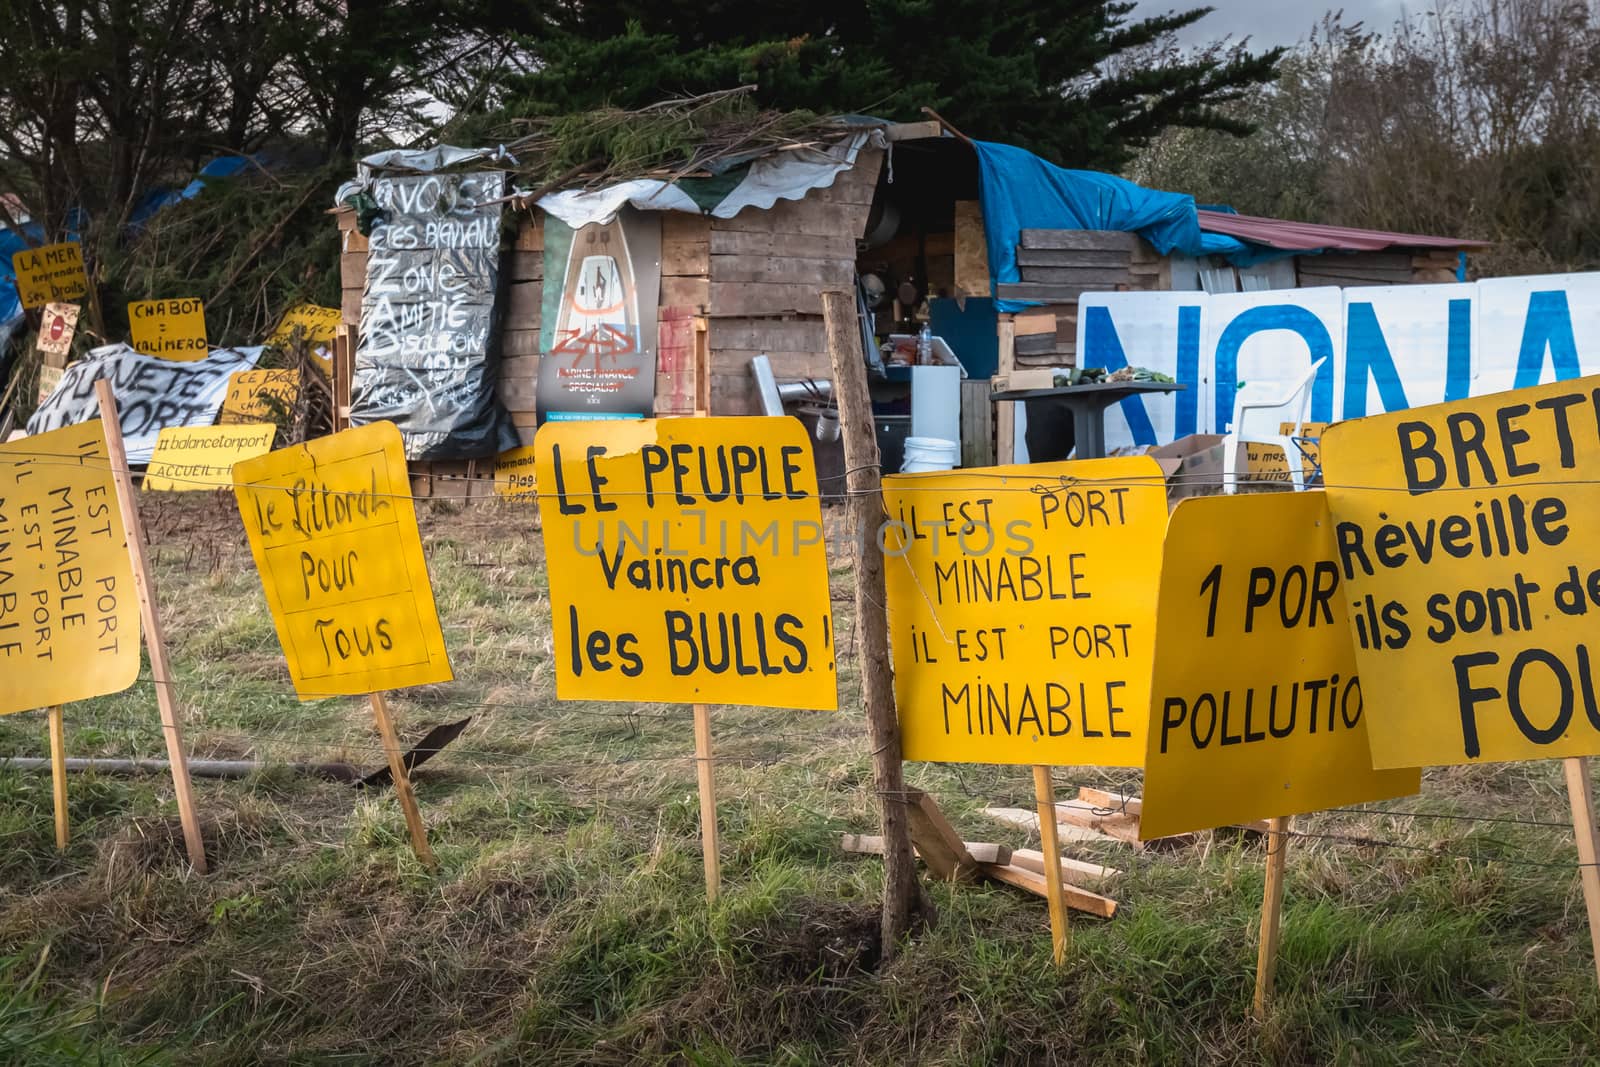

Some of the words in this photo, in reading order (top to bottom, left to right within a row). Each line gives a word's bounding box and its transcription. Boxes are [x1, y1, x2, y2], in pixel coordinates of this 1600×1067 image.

[20, 255, 41, 271] LA
[46, 247, 78, 265] MER
[134, 300, 201, 319] CHABOT
[159, 323, 166, 332] =
[157, 464, 211, 478] ACCUEIL
[508, 474, 537, 490] Plag
[552, 443, 618, 516] LE
[642, 443, 809, 508] PEUPLE
[1040, 487, 1130, 530] PORT
[596, 540, 760, 593] Vaincra
[31, 589, 53, 662] PORT
[95, 576, 119, 655] PORT
[1199, 564, 1222, 638] 1
[1353, 594, 1411, 651] ils
[1427, 573, 1541, 645] sont
[314, 617, 393, 667] Tous
[569, 604, 643, 677] les
[956, 627, 1007, 662] EST
[1049, 624, 1132, 660] PORT
